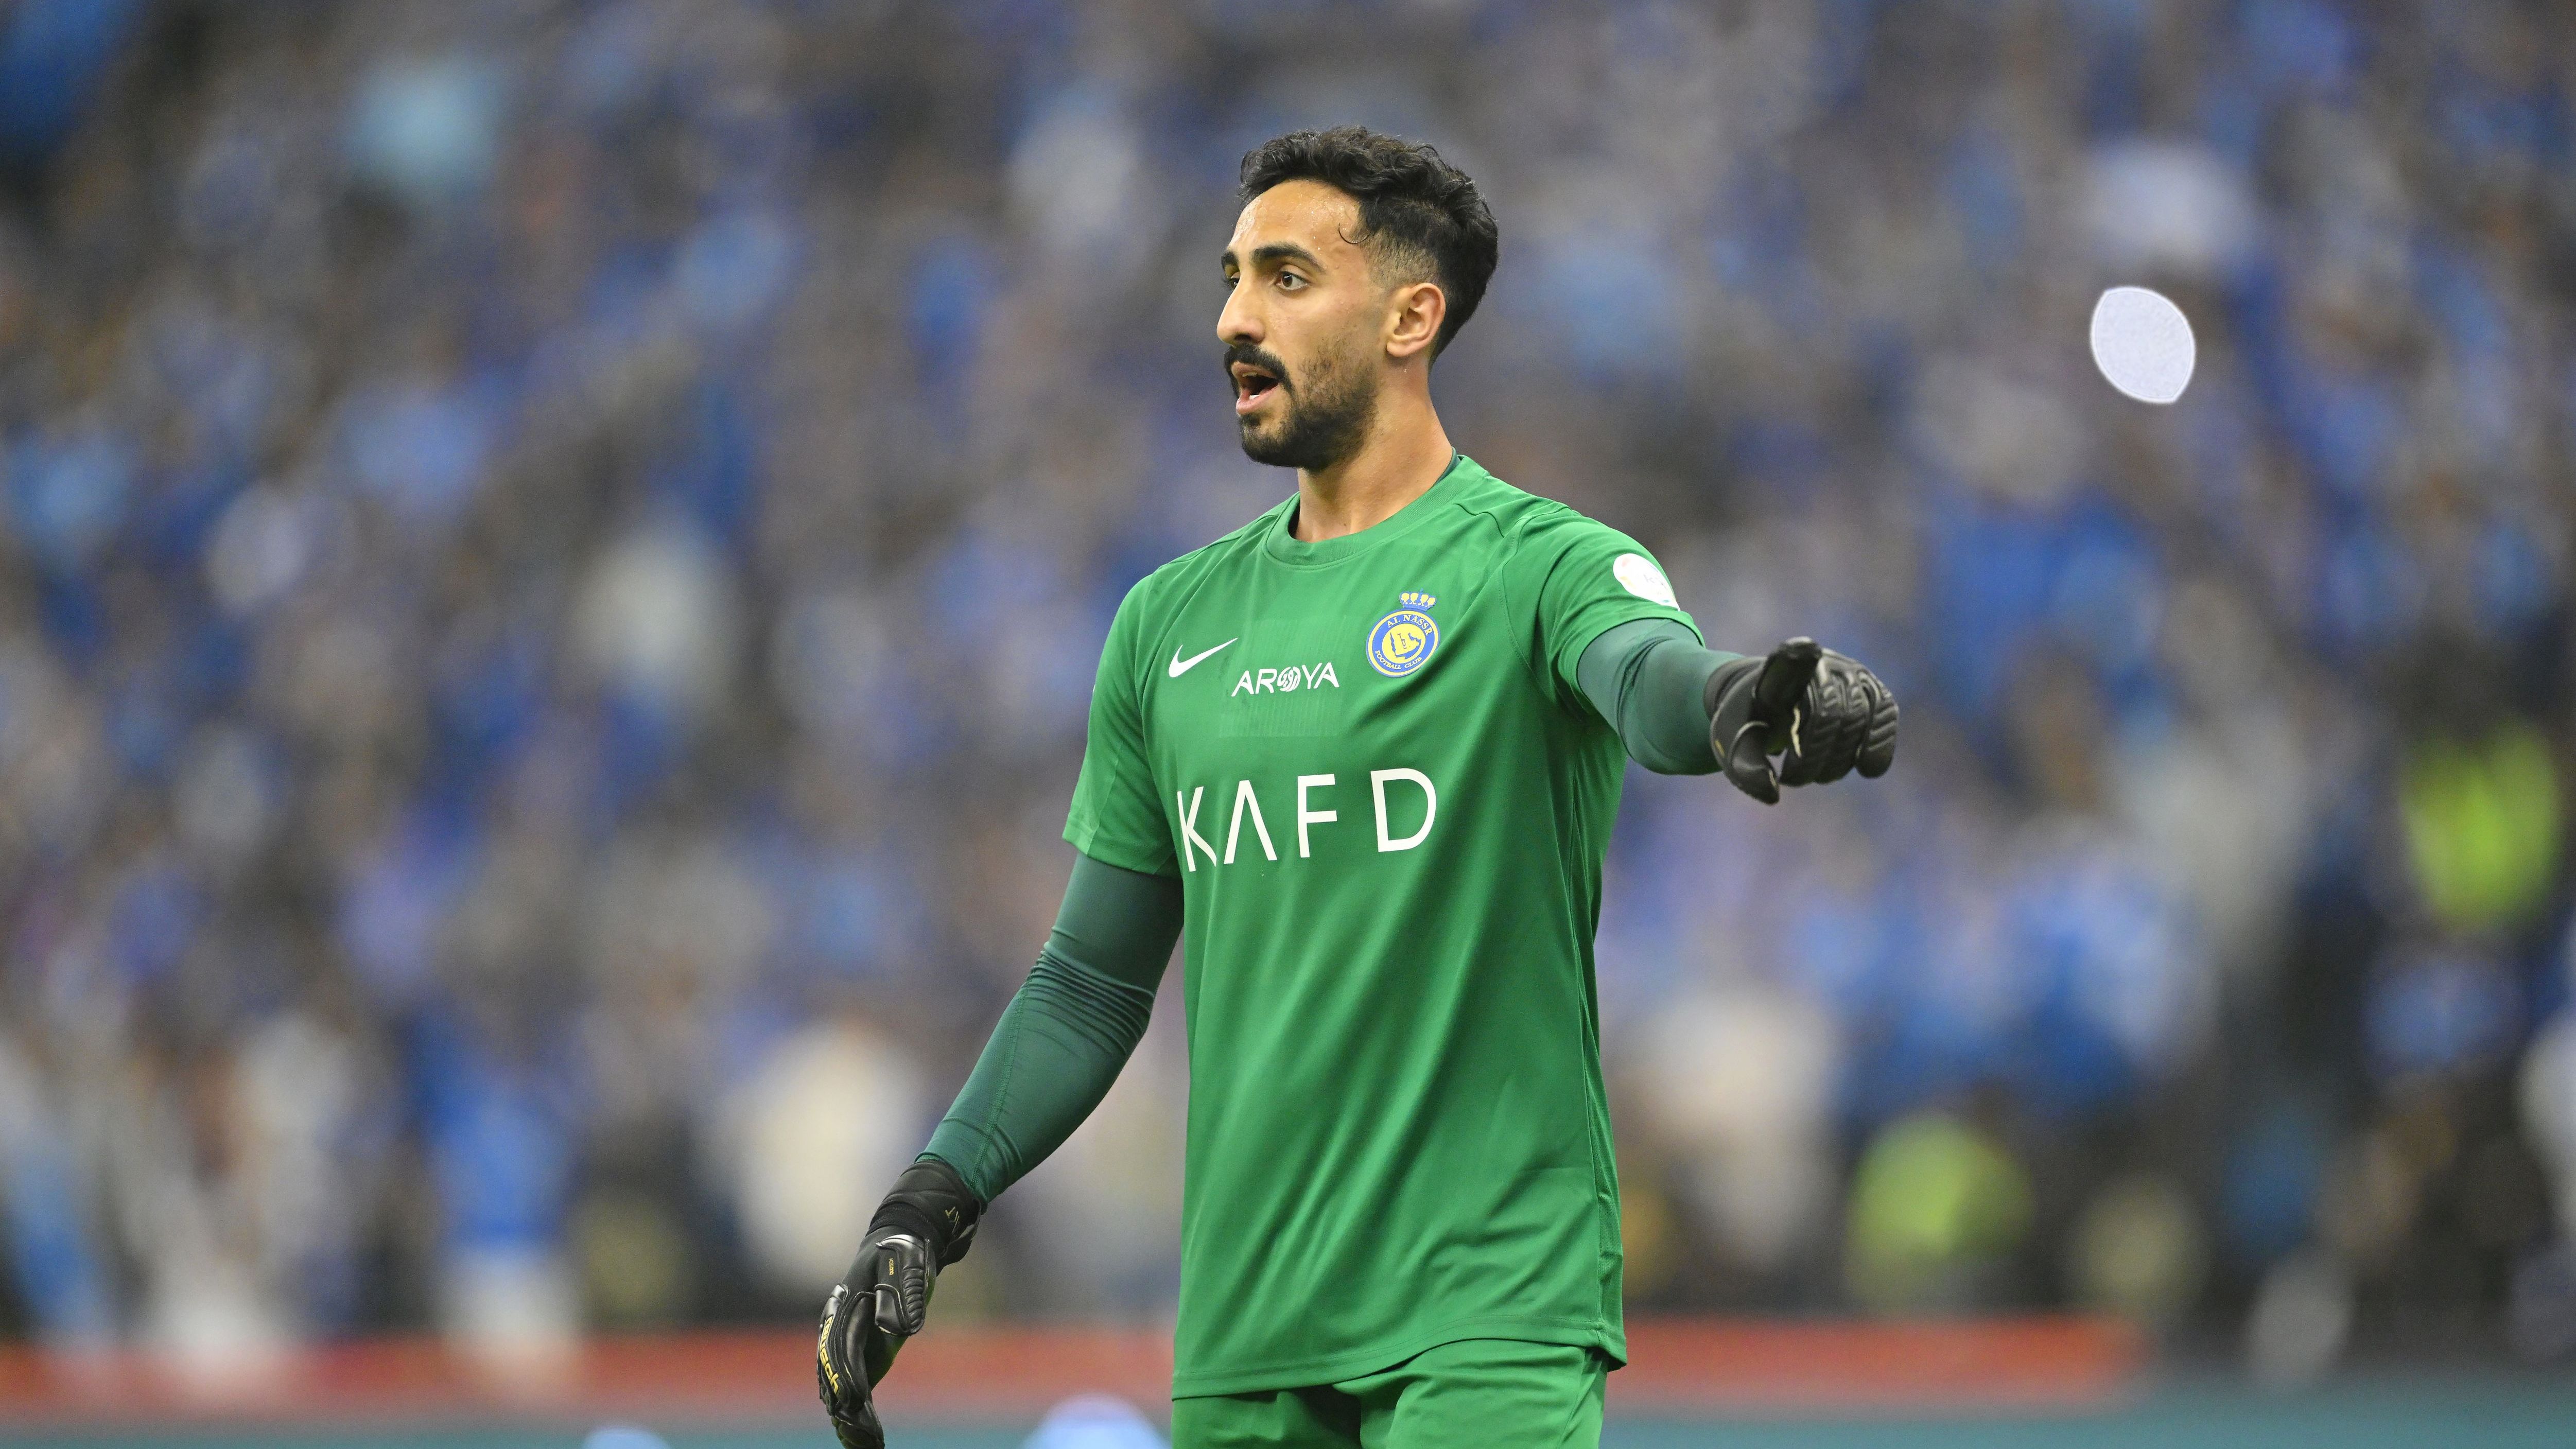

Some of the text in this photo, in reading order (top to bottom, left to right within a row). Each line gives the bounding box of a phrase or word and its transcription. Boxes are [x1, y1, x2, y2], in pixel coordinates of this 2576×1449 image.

[1387, 615, 1433, 636] AL NASSR
[1375, 650, 1422, 670] FOOTBALL CLUB
[1231, 662, 1339, 697] AROYA
[1177, 767, 1437, 872] KAFD
